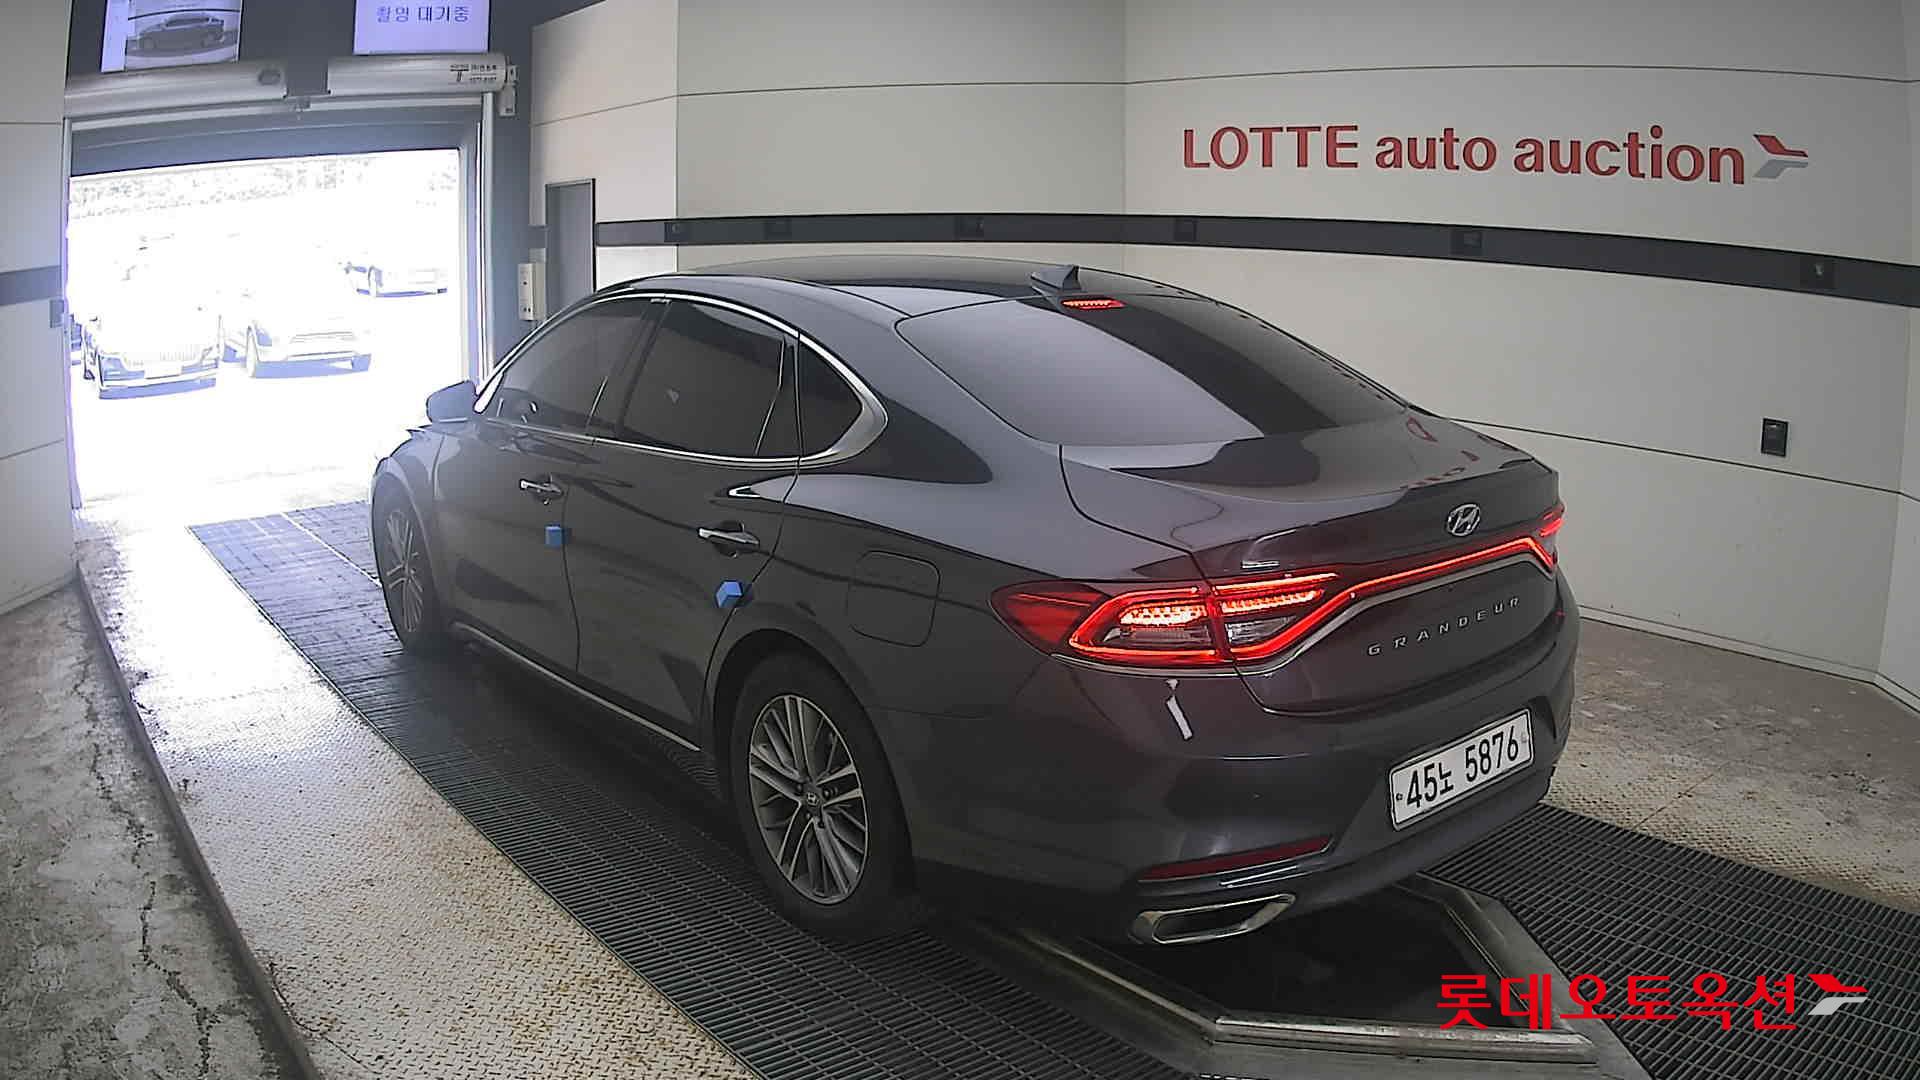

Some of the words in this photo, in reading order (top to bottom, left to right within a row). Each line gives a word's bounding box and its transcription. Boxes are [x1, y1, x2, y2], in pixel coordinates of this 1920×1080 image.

[418, 5, 470, 23] 대기중
[1183, 124, 1359, 169] LOTTE
[1374, 127, 1498, 172] auto
[1513, 124, 1745, 185] auction
[1367, 596, 1520, 656] GRANDEUR
[1406, 761, 1454, 808] 45노
[1464, 725, 1519, 783] 5876
